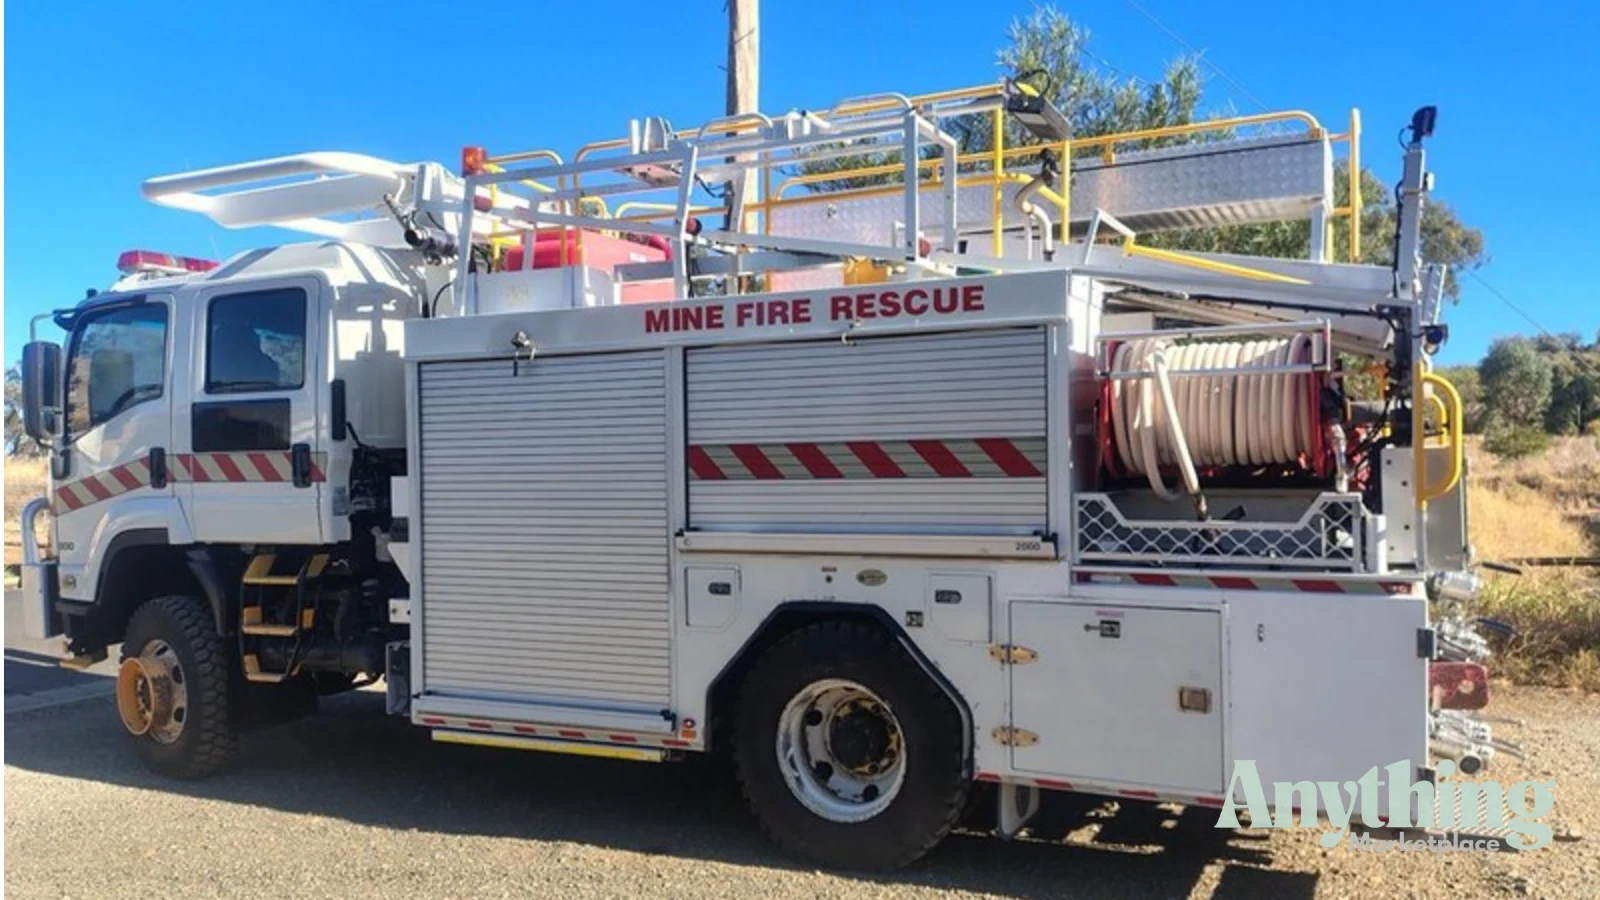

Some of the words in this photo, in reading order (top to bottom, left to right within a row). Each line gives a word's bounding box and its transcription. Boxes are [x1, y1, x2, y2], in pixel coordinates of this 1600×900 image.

[644, 305, 725, 333] MINE
[736, 298, 812, 327] FIRE
[830, 285, 986, 321] RESCUE
